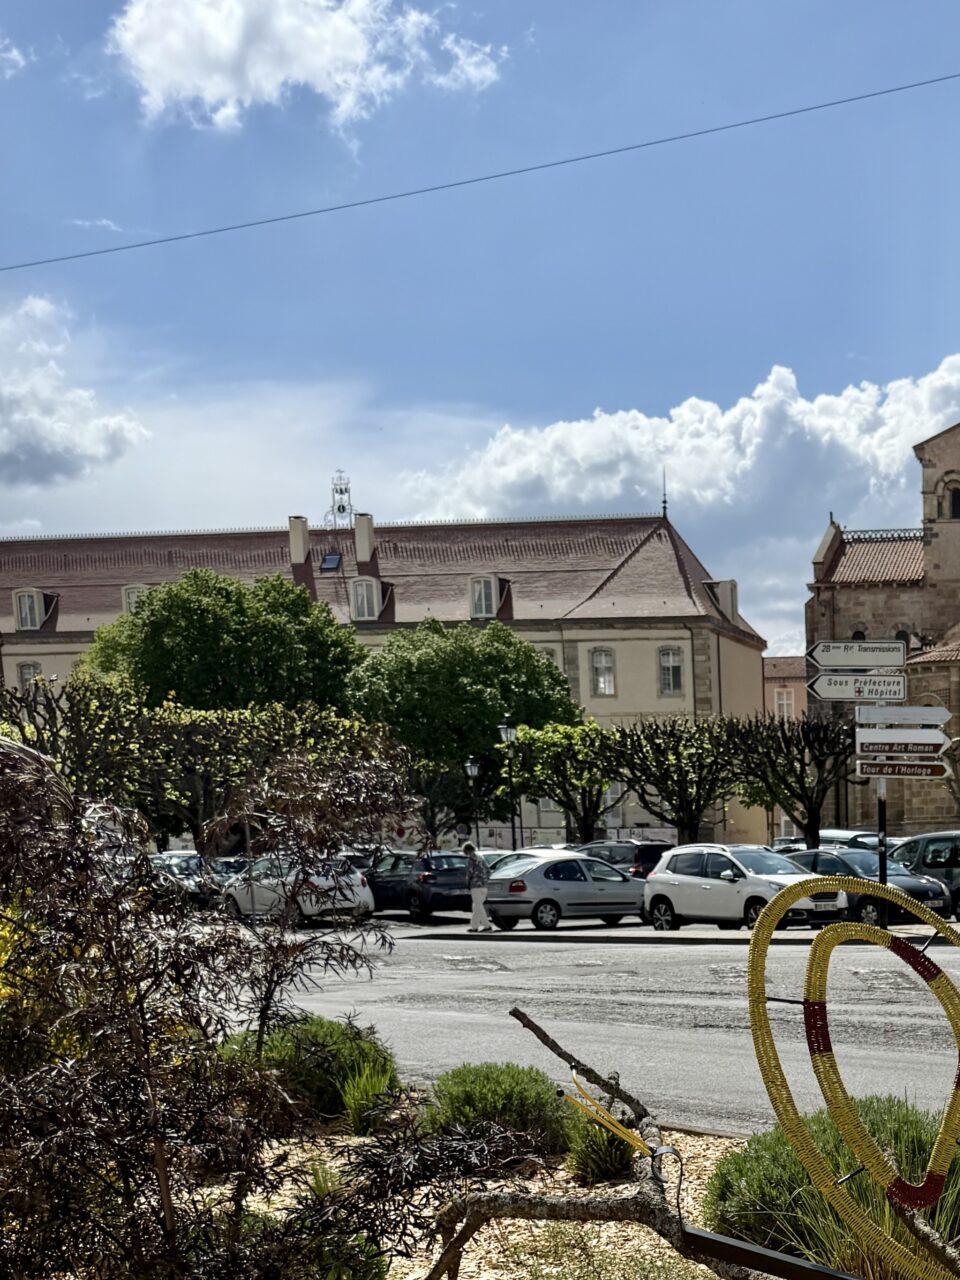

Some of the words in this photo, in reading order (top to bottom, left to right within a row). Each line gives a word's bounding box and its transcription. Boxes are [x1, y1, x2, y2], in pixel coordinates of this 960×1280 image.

[858, 644, 901, 653] Transmissions
[827, 678, 849, 687] Sous
[853, 678, 901, 687] Préfecture
[867, 688, 901, 697] Hôpital
[863, 743, 890, 752] Centre
[892, 743, 905, 752] Art
[907, 743, 934, 752] Roman
[862, 765, 880, 774] Tour
[883, 765, 893, 774] de
[895, 765, 932, 776] l'Horloge
